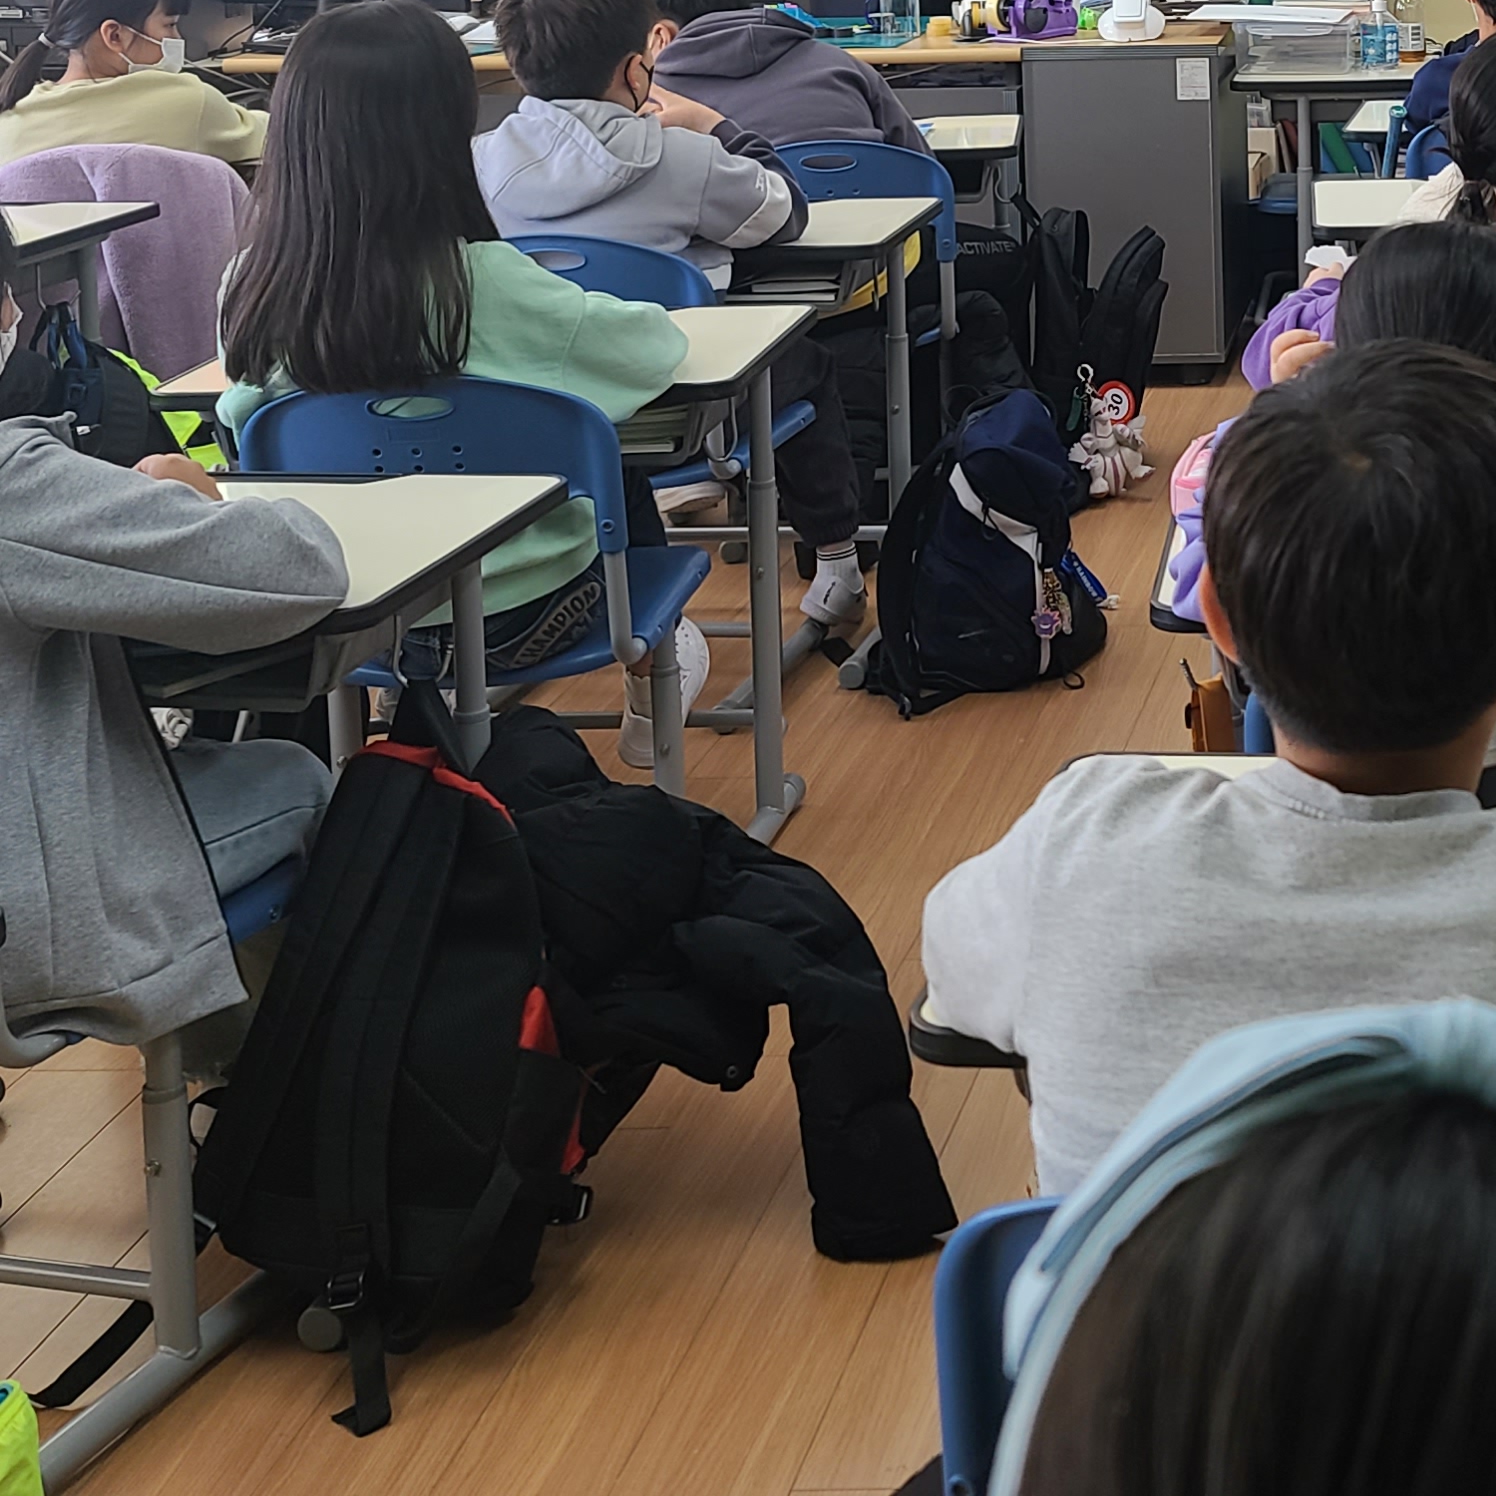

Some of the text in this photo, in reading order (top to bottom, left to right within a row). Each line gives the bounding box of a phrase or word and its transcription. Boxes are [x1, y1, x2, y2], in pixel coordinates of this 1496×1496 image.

[956, 240, 1014, 255] ACTIVATE
[1108, 393, 1123, 415] 30
[514, 585, 597, 664] HAMPION
